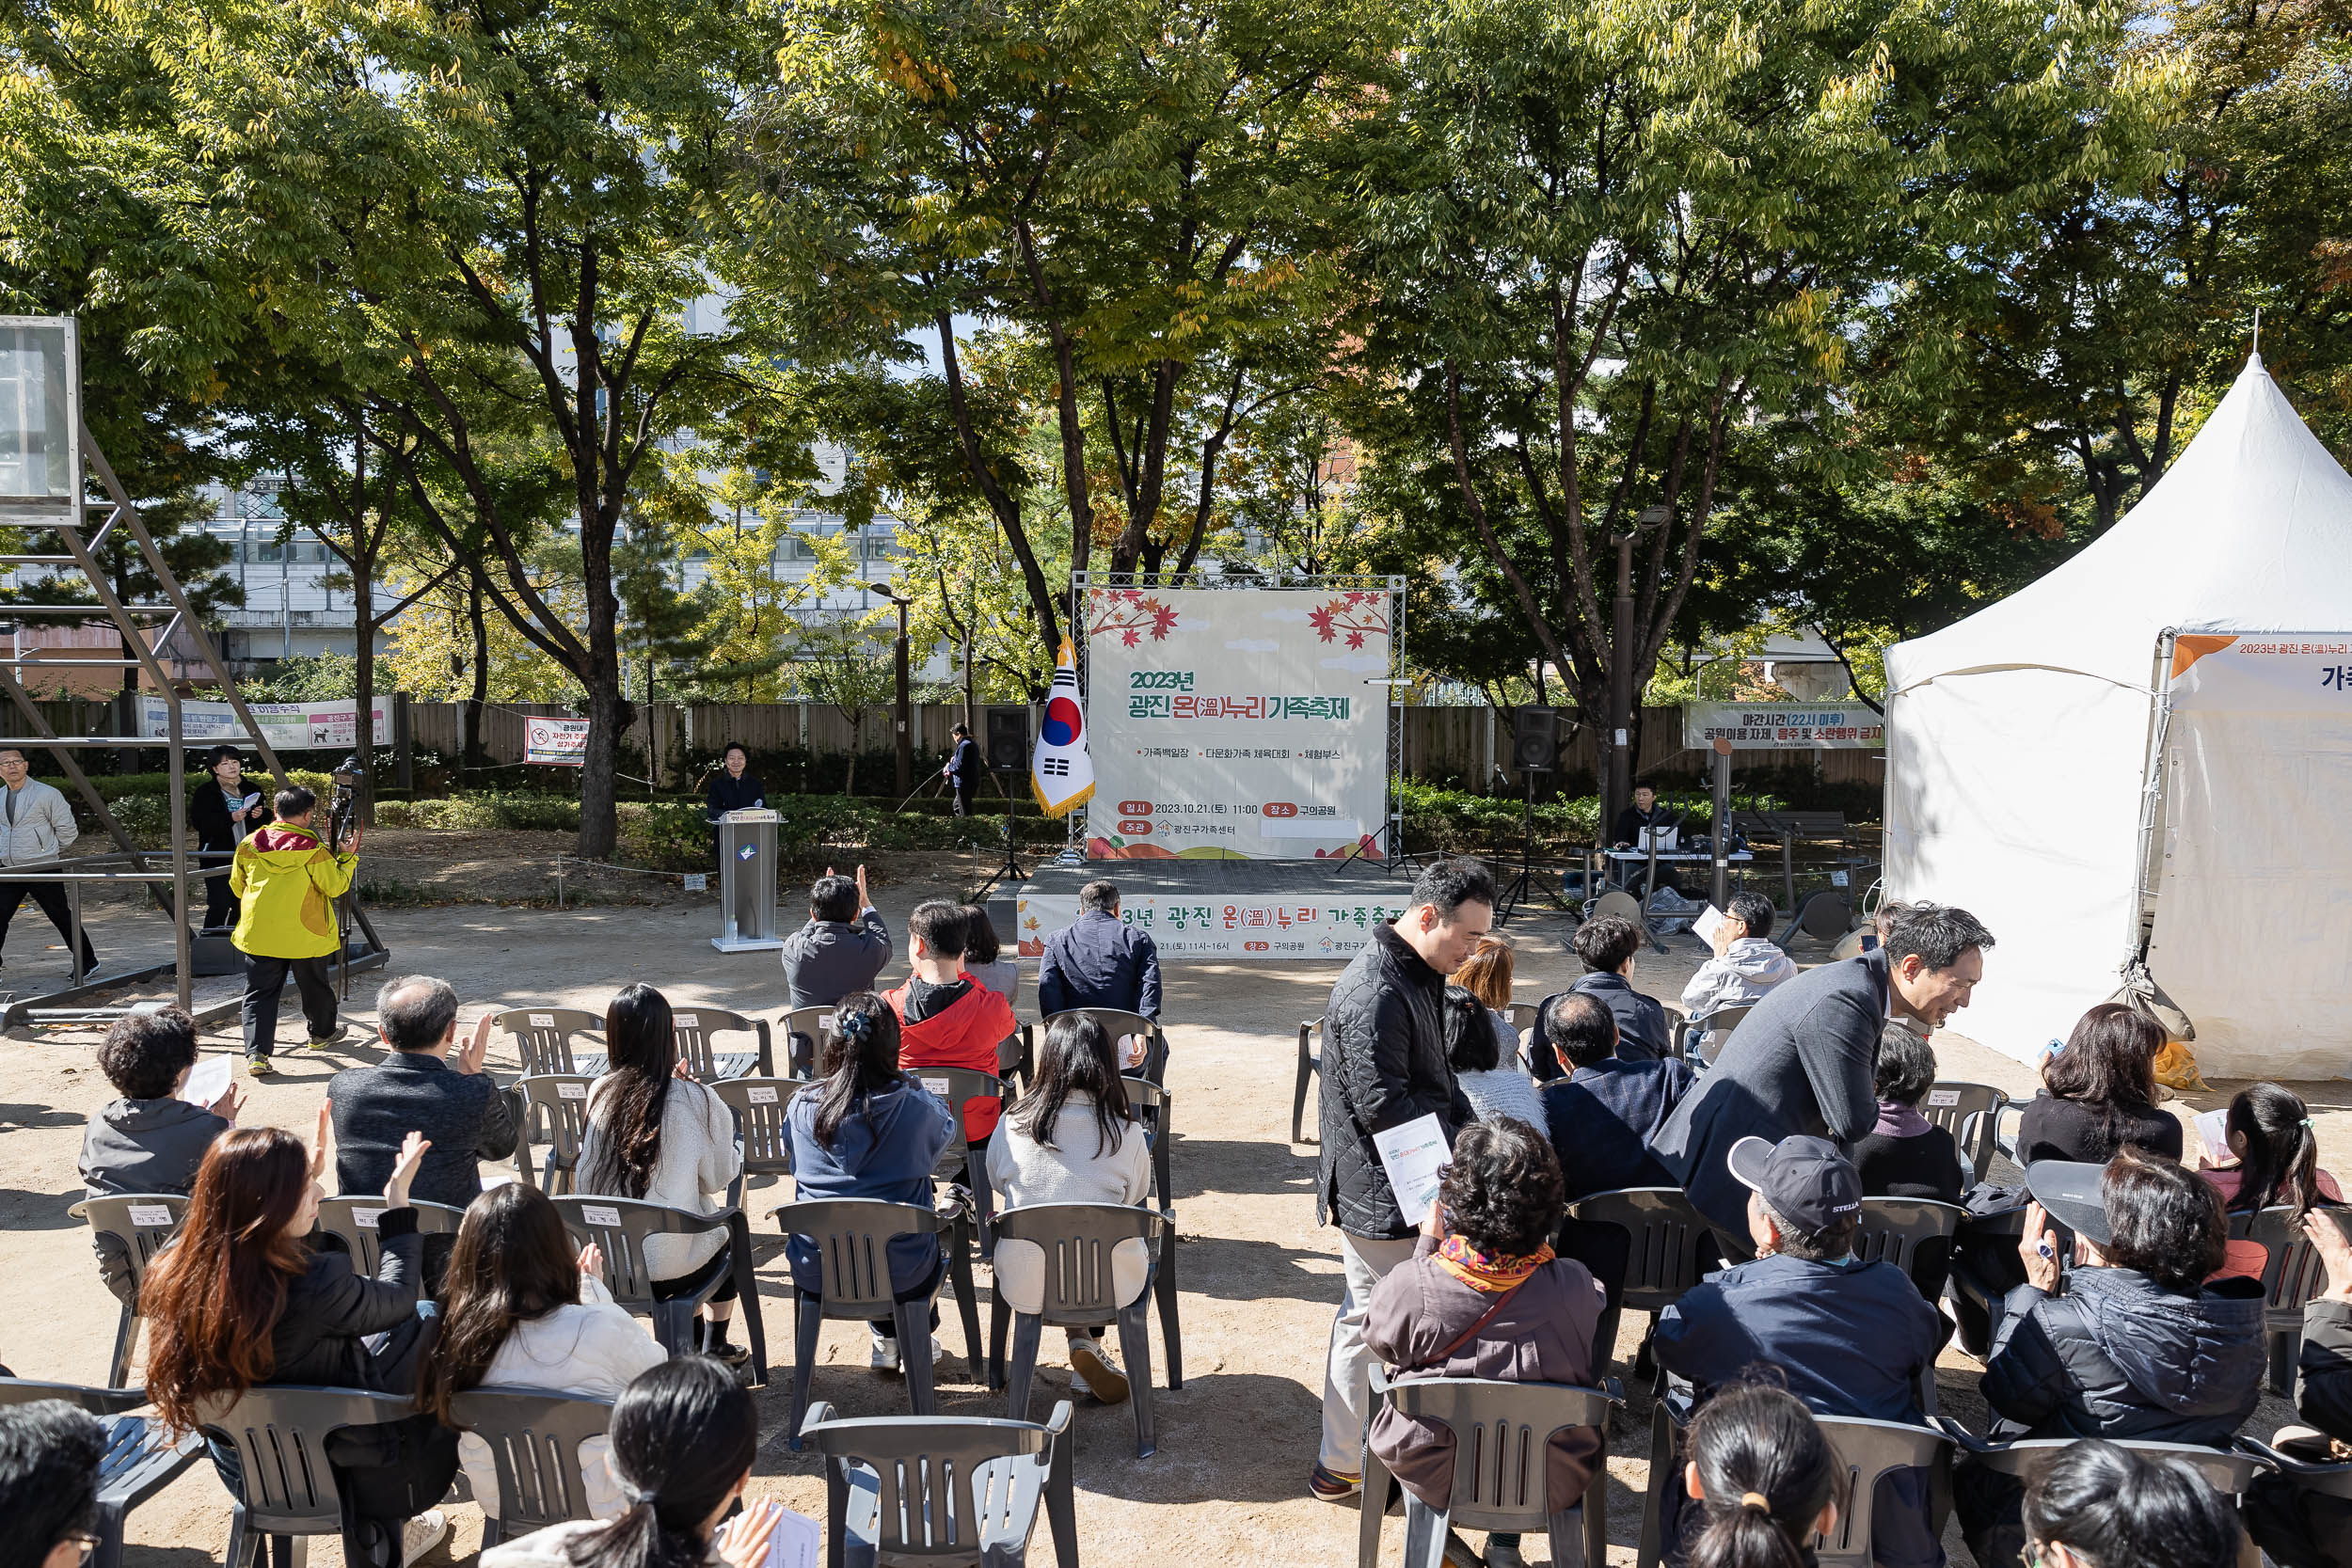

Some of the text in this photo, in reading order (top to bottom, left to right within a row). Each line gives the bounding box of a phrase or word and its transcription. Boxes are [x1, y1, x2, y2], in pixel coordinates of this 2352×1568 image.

[2240, 643, 2277, 654] 2023년
[2279, 643, 2298, 654] 광진
[1130, 671, 1194, 691] 2023년
[1129, 695, 1169, 719] 광진
[1268, 696, 1350, 720] 가족축제
[1819, 713, 1845, 727] 이후)
[1750, 728, 1774, 741] 자제,
[1777, 728, 1799, 740] 음주
[1801, 728, 1813, 740] 및
[1814, 728, 1857, 740] 소란행위
[1859, 728, 1882, 740] 금지
[1143, 748, 1189, 758] 가족백일장
[1206, 749, 1290, 759] 다문화가족 체육대회
[1304, 750, 1341, 760] 체험부스
[1126, 804, 1146, 813] 일시
[1233, 804, 1258, 815] 11:00
[1270, 805, 1291, 815] 장소
[1299, 805, 1336, 816] 구의공원
[1125, 823, 1145, 832] 주관
[1174, 825, 1235, 835] 광진구가족센터
[1168, 906, 1212, 929] 광진
[1189, 942, 1230, 951] 11시~16시
[1248, 942, 1266, 950] 장소
[1273, 942, 1305, 951] 구의공원
